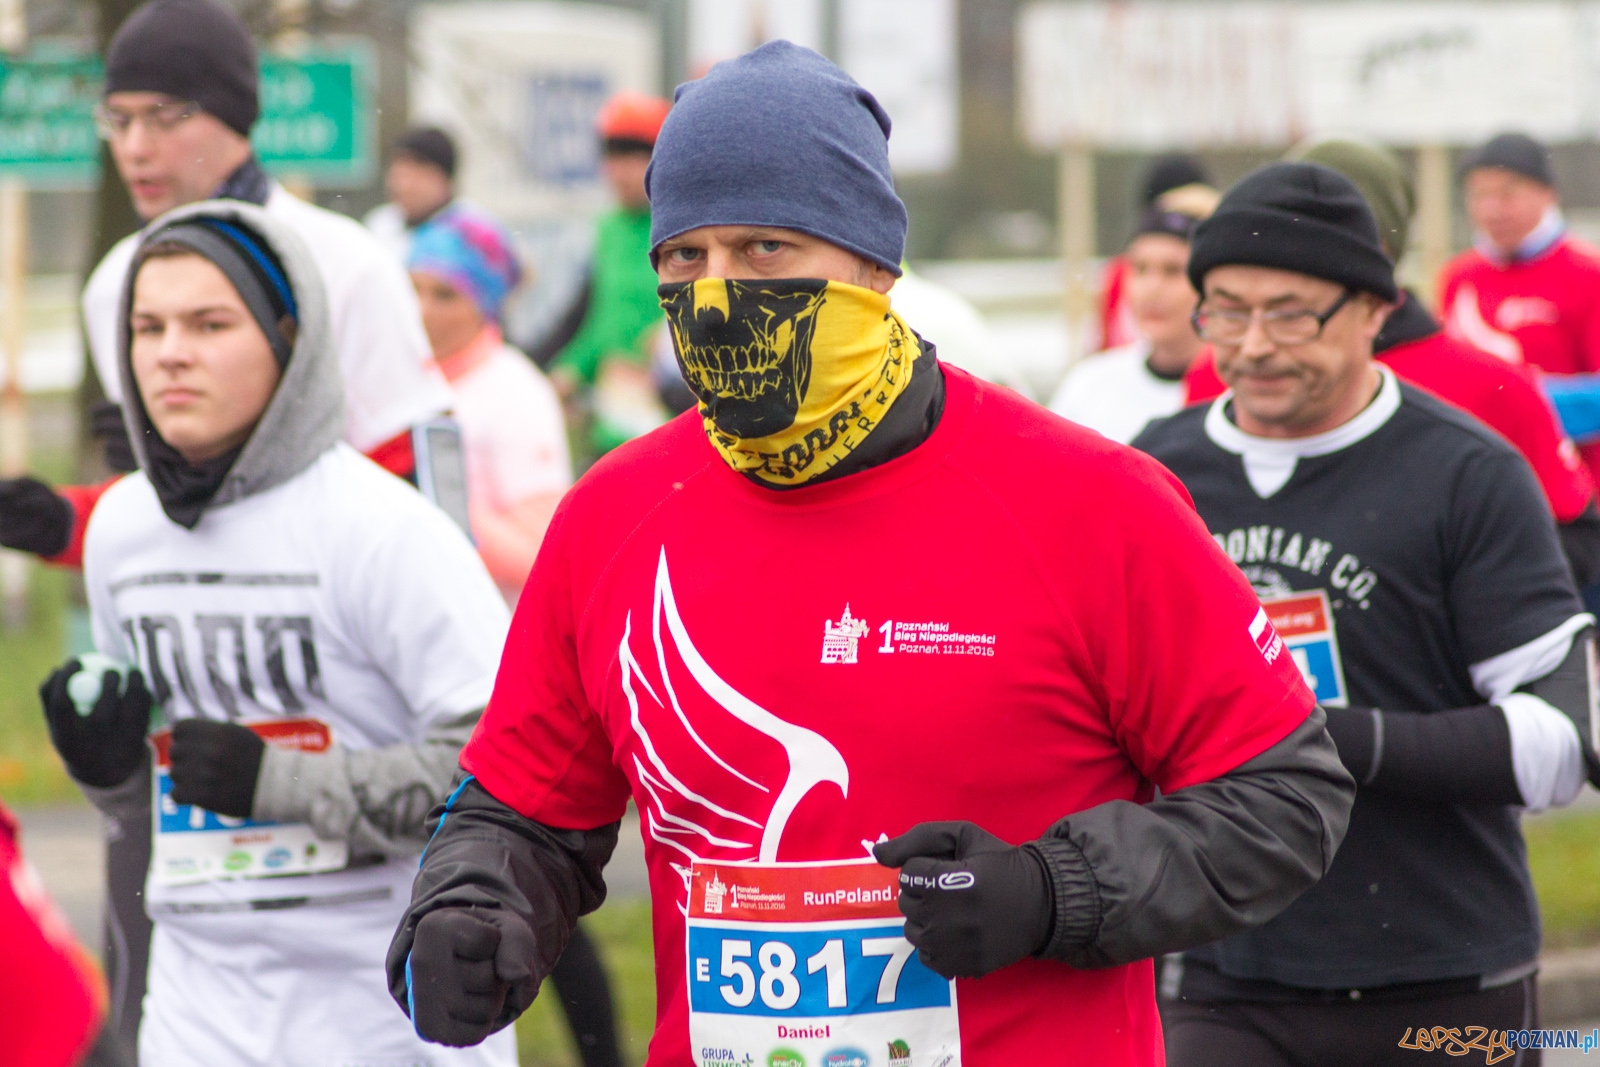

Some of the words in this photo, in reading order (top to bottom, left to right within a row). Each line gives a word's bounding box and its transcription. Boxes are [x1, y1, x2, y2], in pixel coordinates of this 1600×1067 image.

[895, 621, 949, 632] Poznański
[878, 620, 895, 653] 1
[894, 631, 916, 642] Bieg
[918, 632, 996, 644] Niepodległości
[943, 644, 995, 657] 11.11.2016
[900, 873, 935, 889] Kale
[730, 884, 739, 908] 1
[803, 886, 902, 906] RunPoland.
[696, 957, 710, 982] E
[719, 936, 917, 1011] 5817
[777, 1024, 831, 1039] Daniel
[702, 1047, 735, 1062] GRUPA
